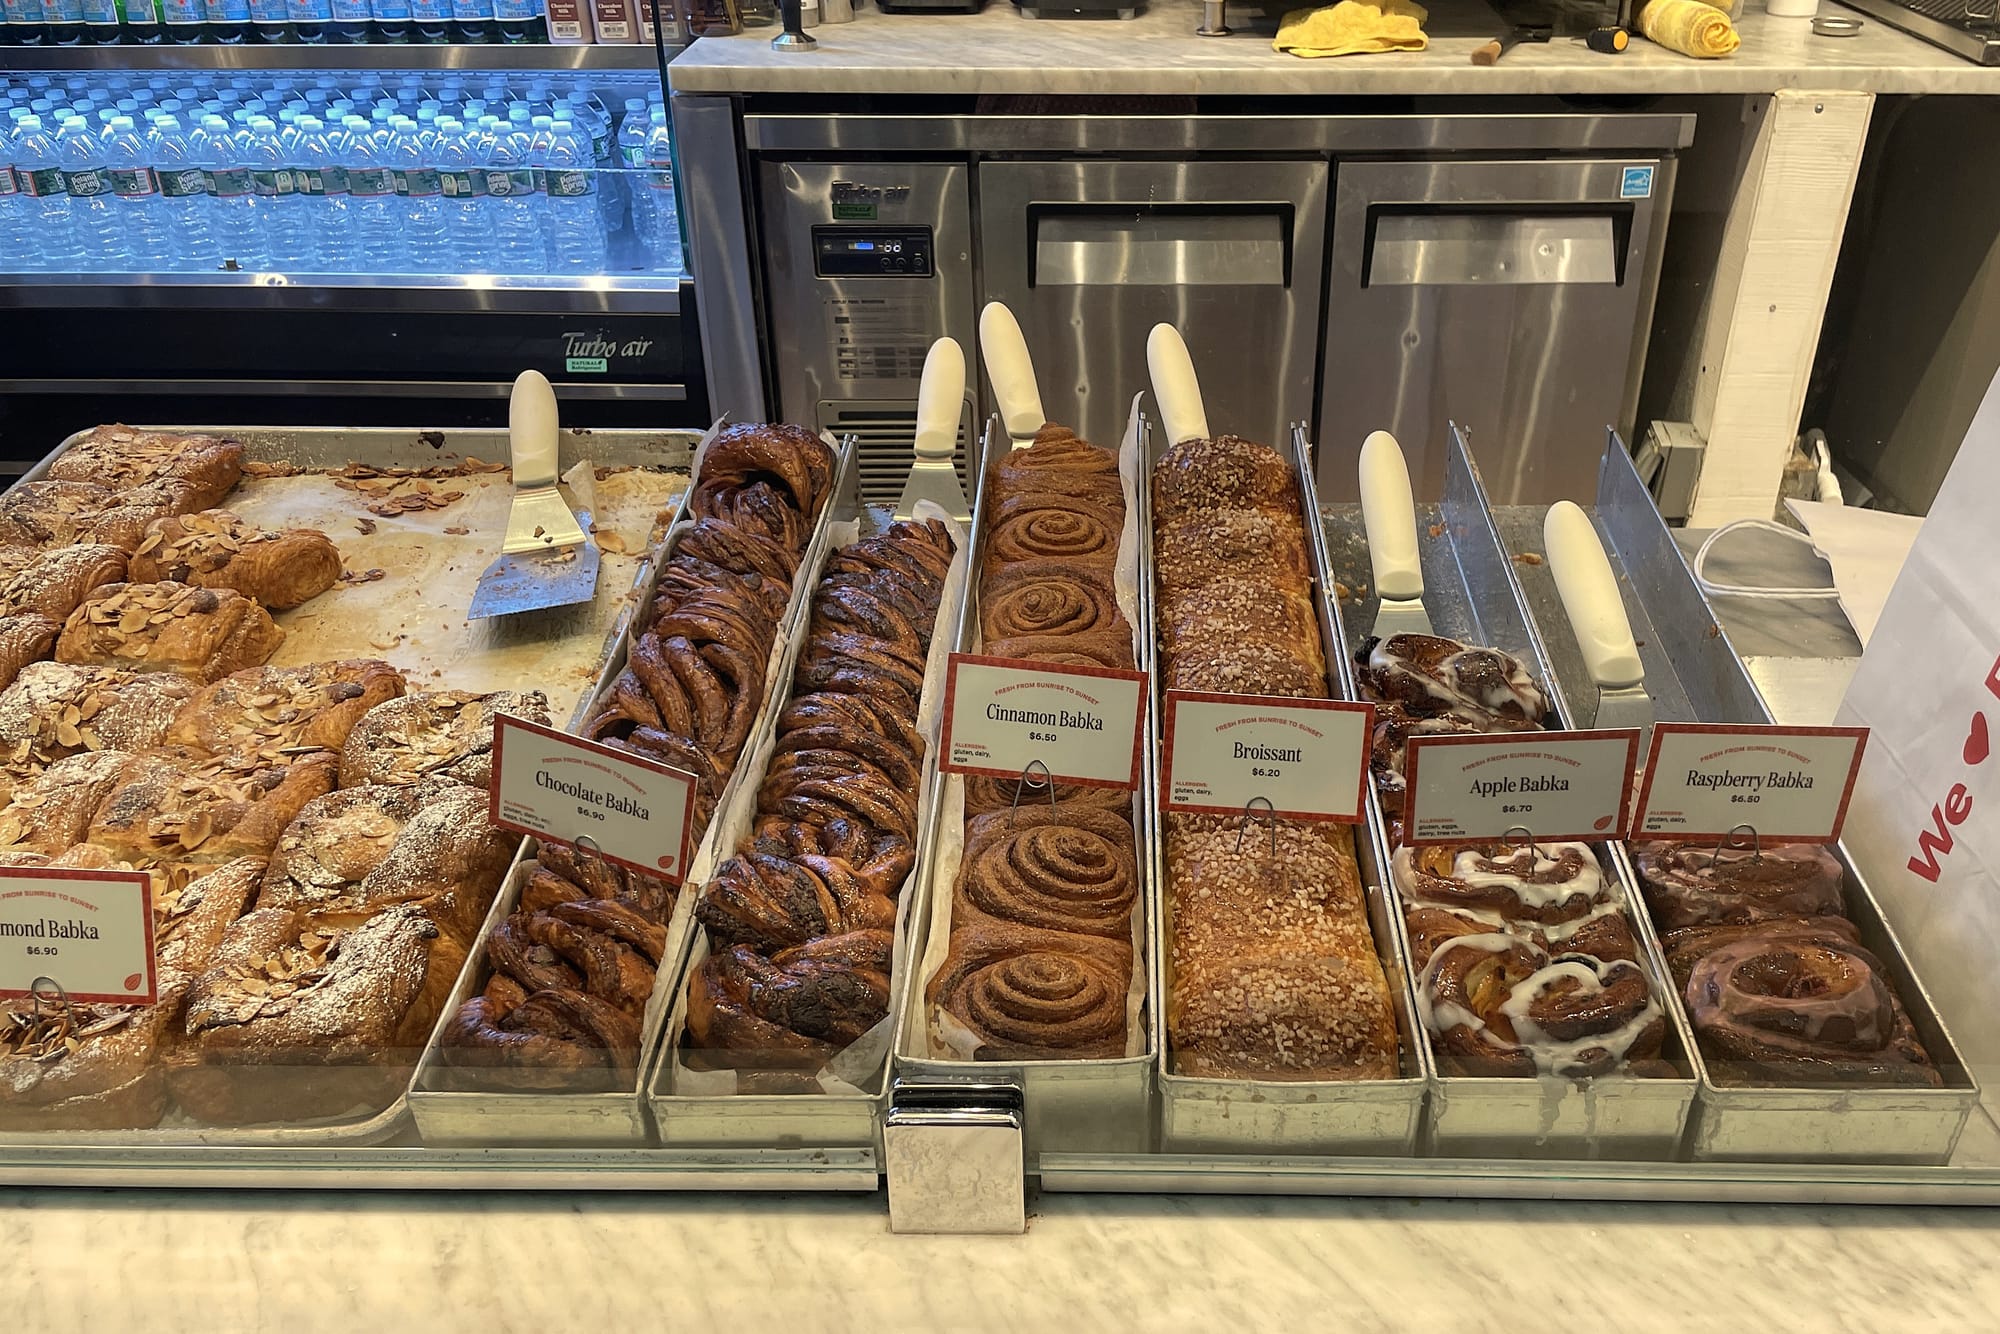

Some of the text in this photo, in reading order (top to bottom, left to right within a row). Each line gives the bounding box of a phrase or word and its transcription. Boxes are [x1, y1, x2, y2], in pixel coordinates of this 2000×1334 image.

[561, 332, 653, 358] Turbo air
[994, 682, 1099, 705] FRESH FROM SUNRISE TO SUNSET
[986, 703, 1103, 731] Cinnamon Babka
[1215, 717, 1324, 738] FRESH FROM SUNRISE TO SUNSET
[1029, 731, 1057, 742] $6.50
[1233, 741, 1302, 763] Broissant
[1724, 746, 1745, 754] FROM
[612, 770, 622, 779] TO
[1252, 767, 1281, 778] $6.20
[1686, 770, 1813, 792] Raspberry Babka
[536, 770, 650, 821] Chocolate Babka
[1469, 775, 1569, 798] Apple Babka
[1502, 804, 1532, 813] $6.70
[1730, 794, 1761, 803] $6.50
[577, 806, 605, 822] $6.90
[1907, 782, 1973, 883] We
[1, 890, 99, 912] FROM SUNRISE TO SUNSET
[47, 919, 100, 940] Babka
[26, 945, 58, 956] $6.90
